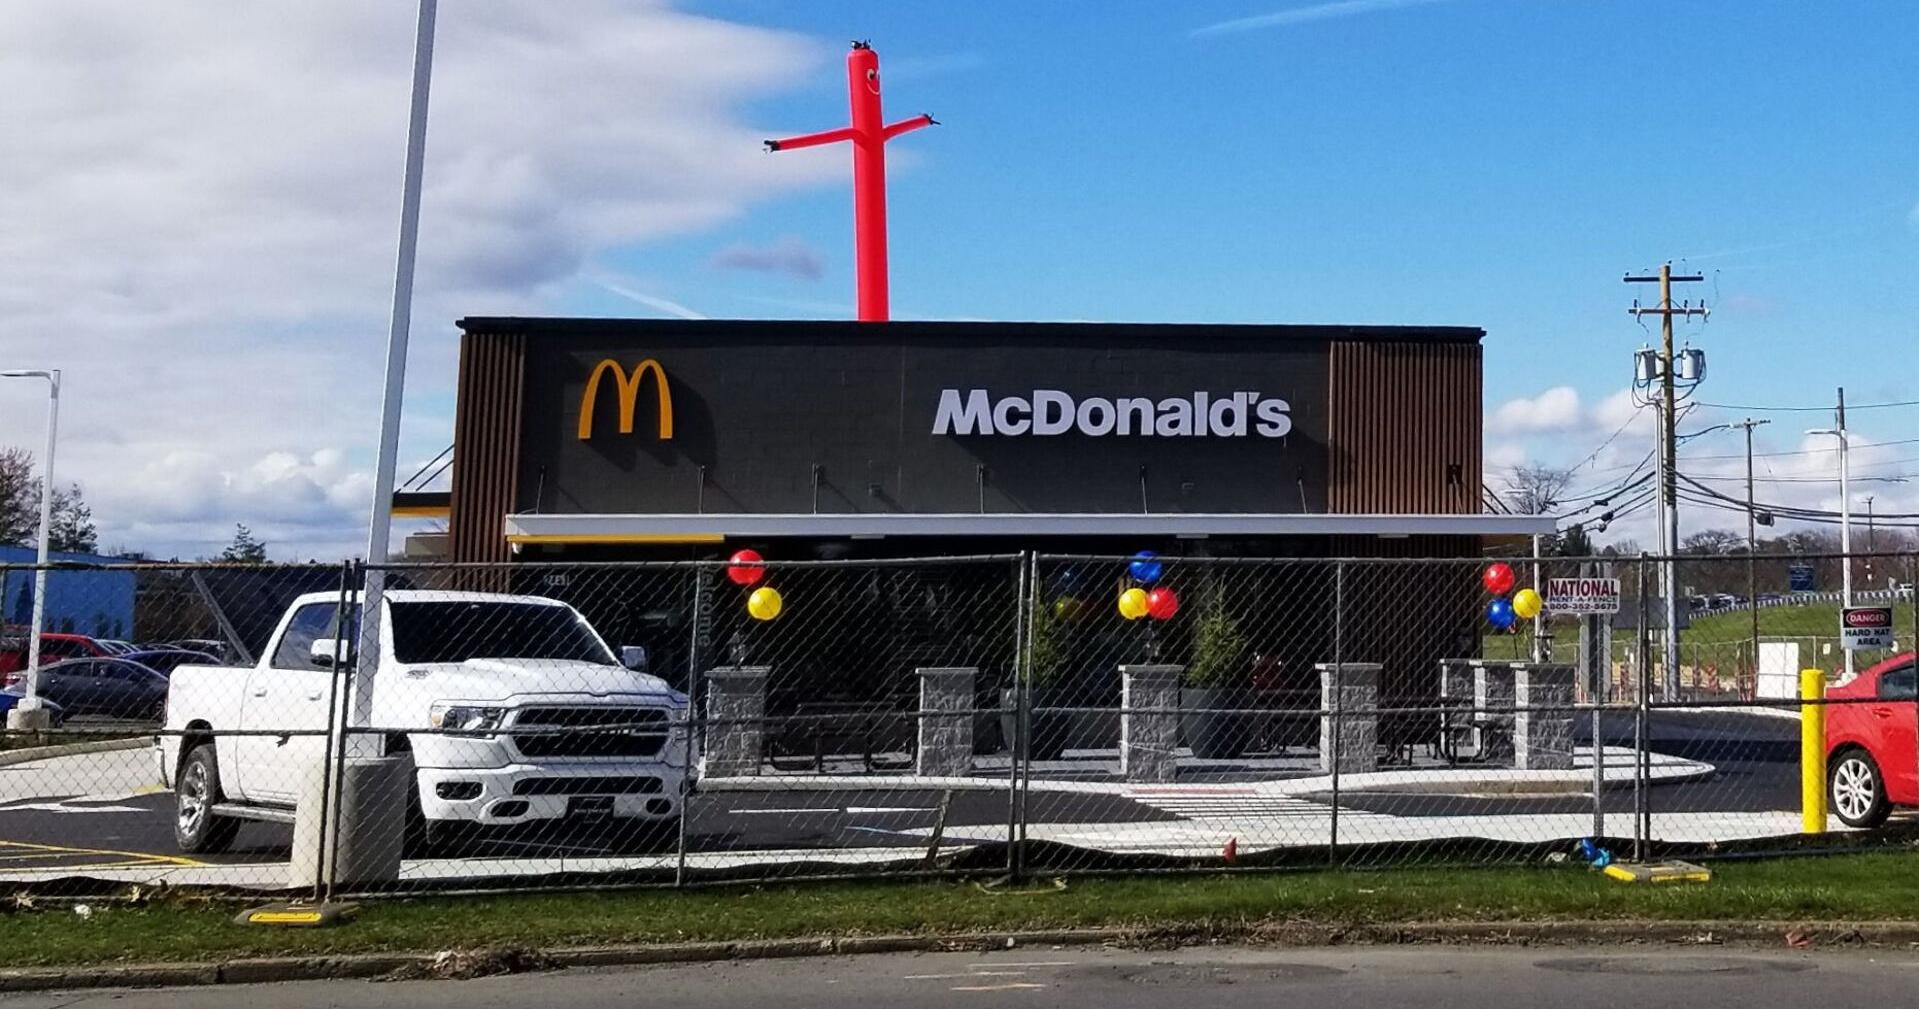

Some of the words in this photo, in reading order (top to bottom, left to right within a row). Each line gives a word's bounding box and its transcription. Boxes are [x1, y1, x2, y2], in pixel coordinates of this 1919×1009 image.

[931, 389, 1293, 438] McDonald's
[1550, 580, 1618, 596] NATIONAL
[1850, 613, 1886, 622] DANGER
[1845, 629, 1871, 637] HARD
[1874, 628, 1890, 636] HAT
